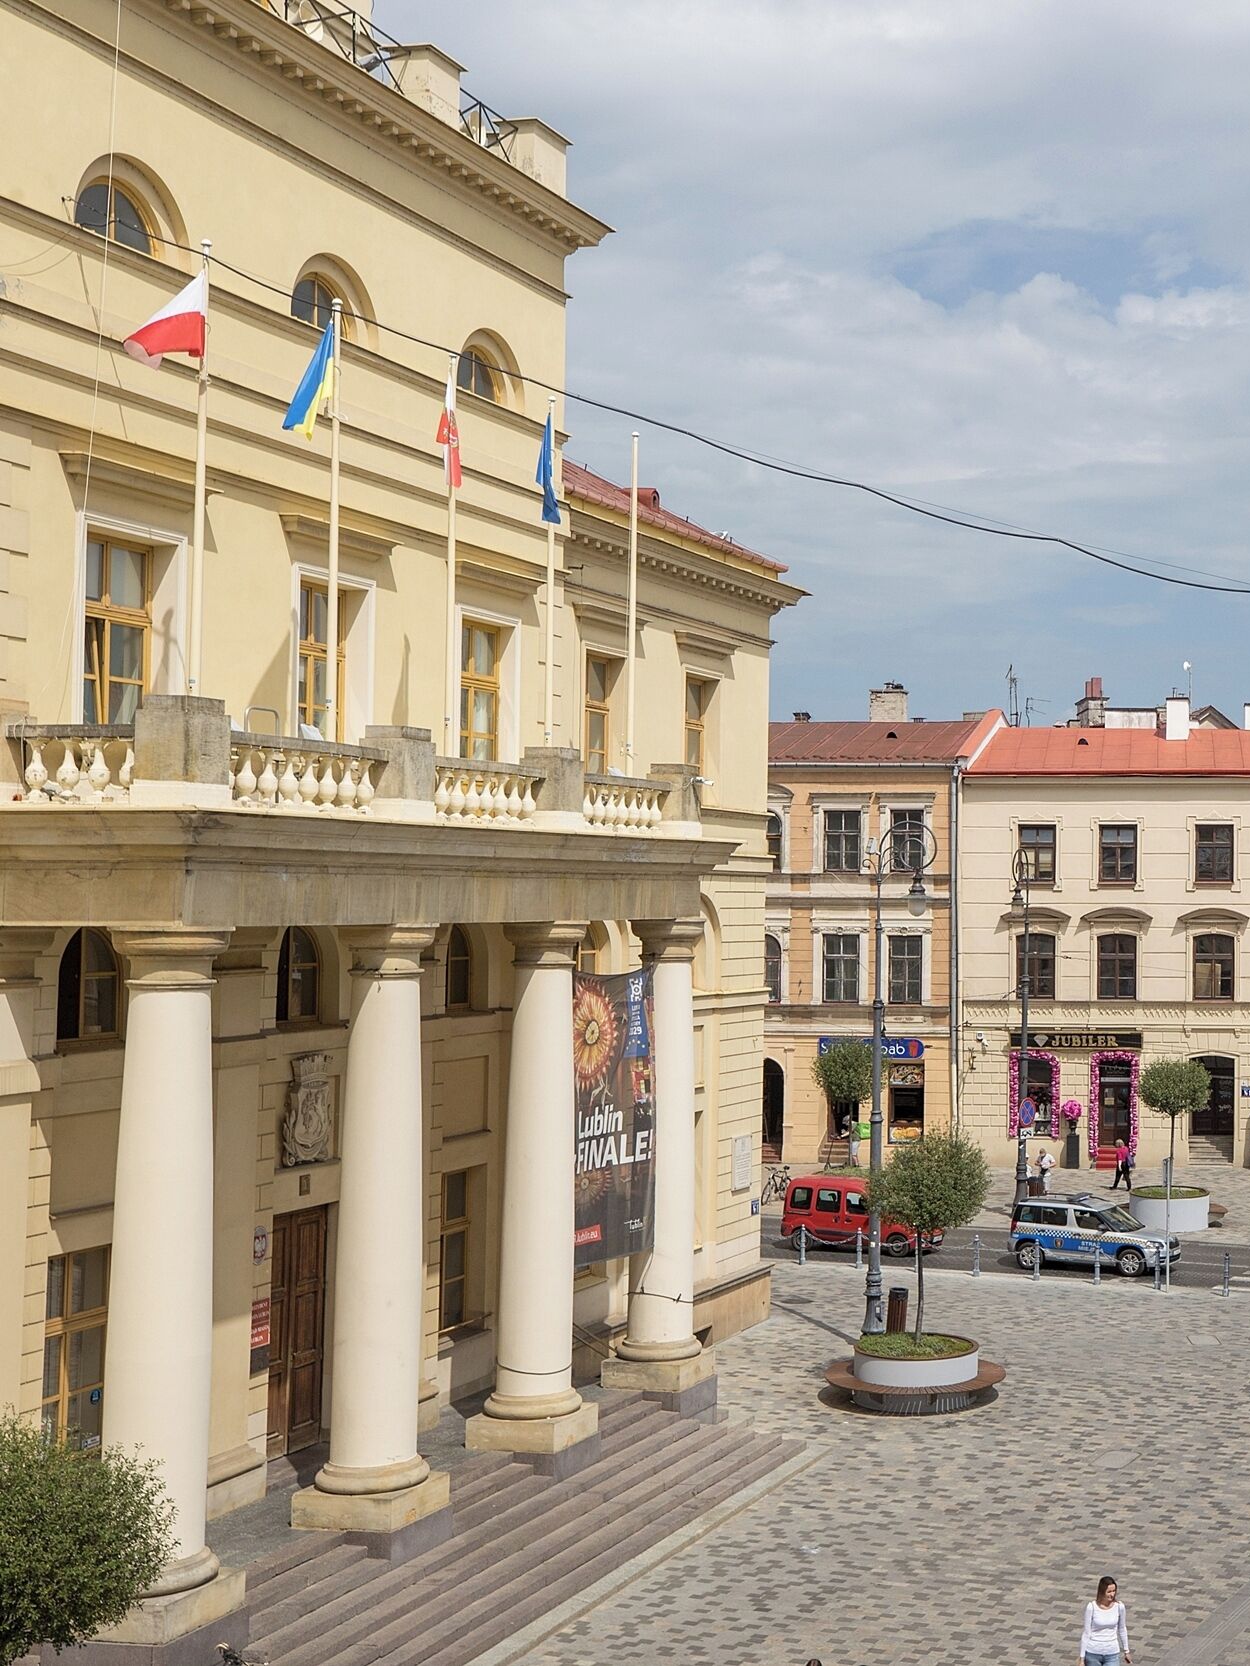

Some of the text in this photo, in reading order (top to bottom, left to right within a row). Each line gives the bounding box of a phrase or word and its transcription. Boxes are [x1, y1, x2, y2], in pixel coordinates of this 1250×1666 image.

[1051, 1034, 1119, 1047] JUBILER
[578, 1104, 623, 1139] Lublin
[576, 1129, 653, 1174] FINALE!
